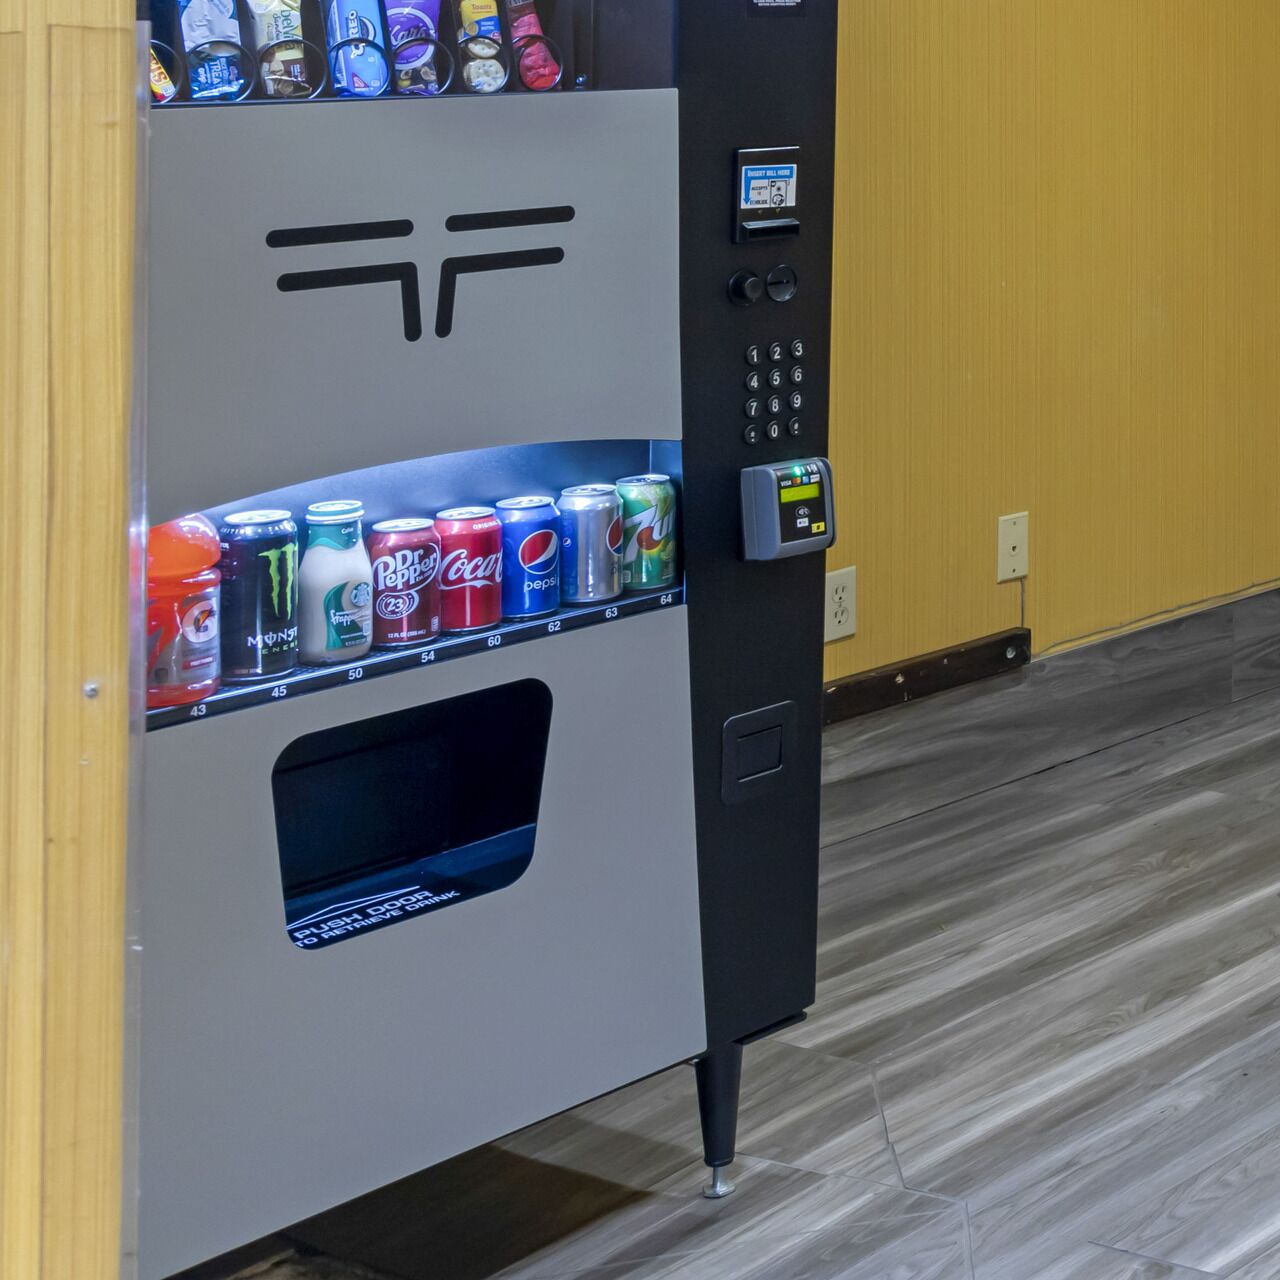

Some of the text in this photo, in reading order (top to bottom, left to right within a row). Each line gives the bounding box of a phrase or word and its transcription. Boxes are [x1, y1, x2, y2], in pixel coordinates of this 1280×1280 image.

[751, 342, 803, 363] 1 2 3
[750, 368, 802, 388] 4 5 6
[750, 394, 801, 415] 7 8 9
[770, 424, 779, 438] 0
[395, 548, 424, 572] Dr
[373, 552, 437, 591] Pepper
[386, 598, 404, 612] 23
[660, 594, 672, 605] 64
[605, 607, 618, 618] 63
[547, 621, 561, 632] 62
[247, 625, 298, 647] MONST
[487, 635, 501, 647] 60
[421, 651, 435, 663] 54
[348, 668, 363, 680] 50
[271, 686, 287, 698] 45
[190, 704, 207, 716] 43
[293, 890, 433, 939] PUSH DOOR
[295, 890, 461, 948] TO RETRIEVE DRINK
